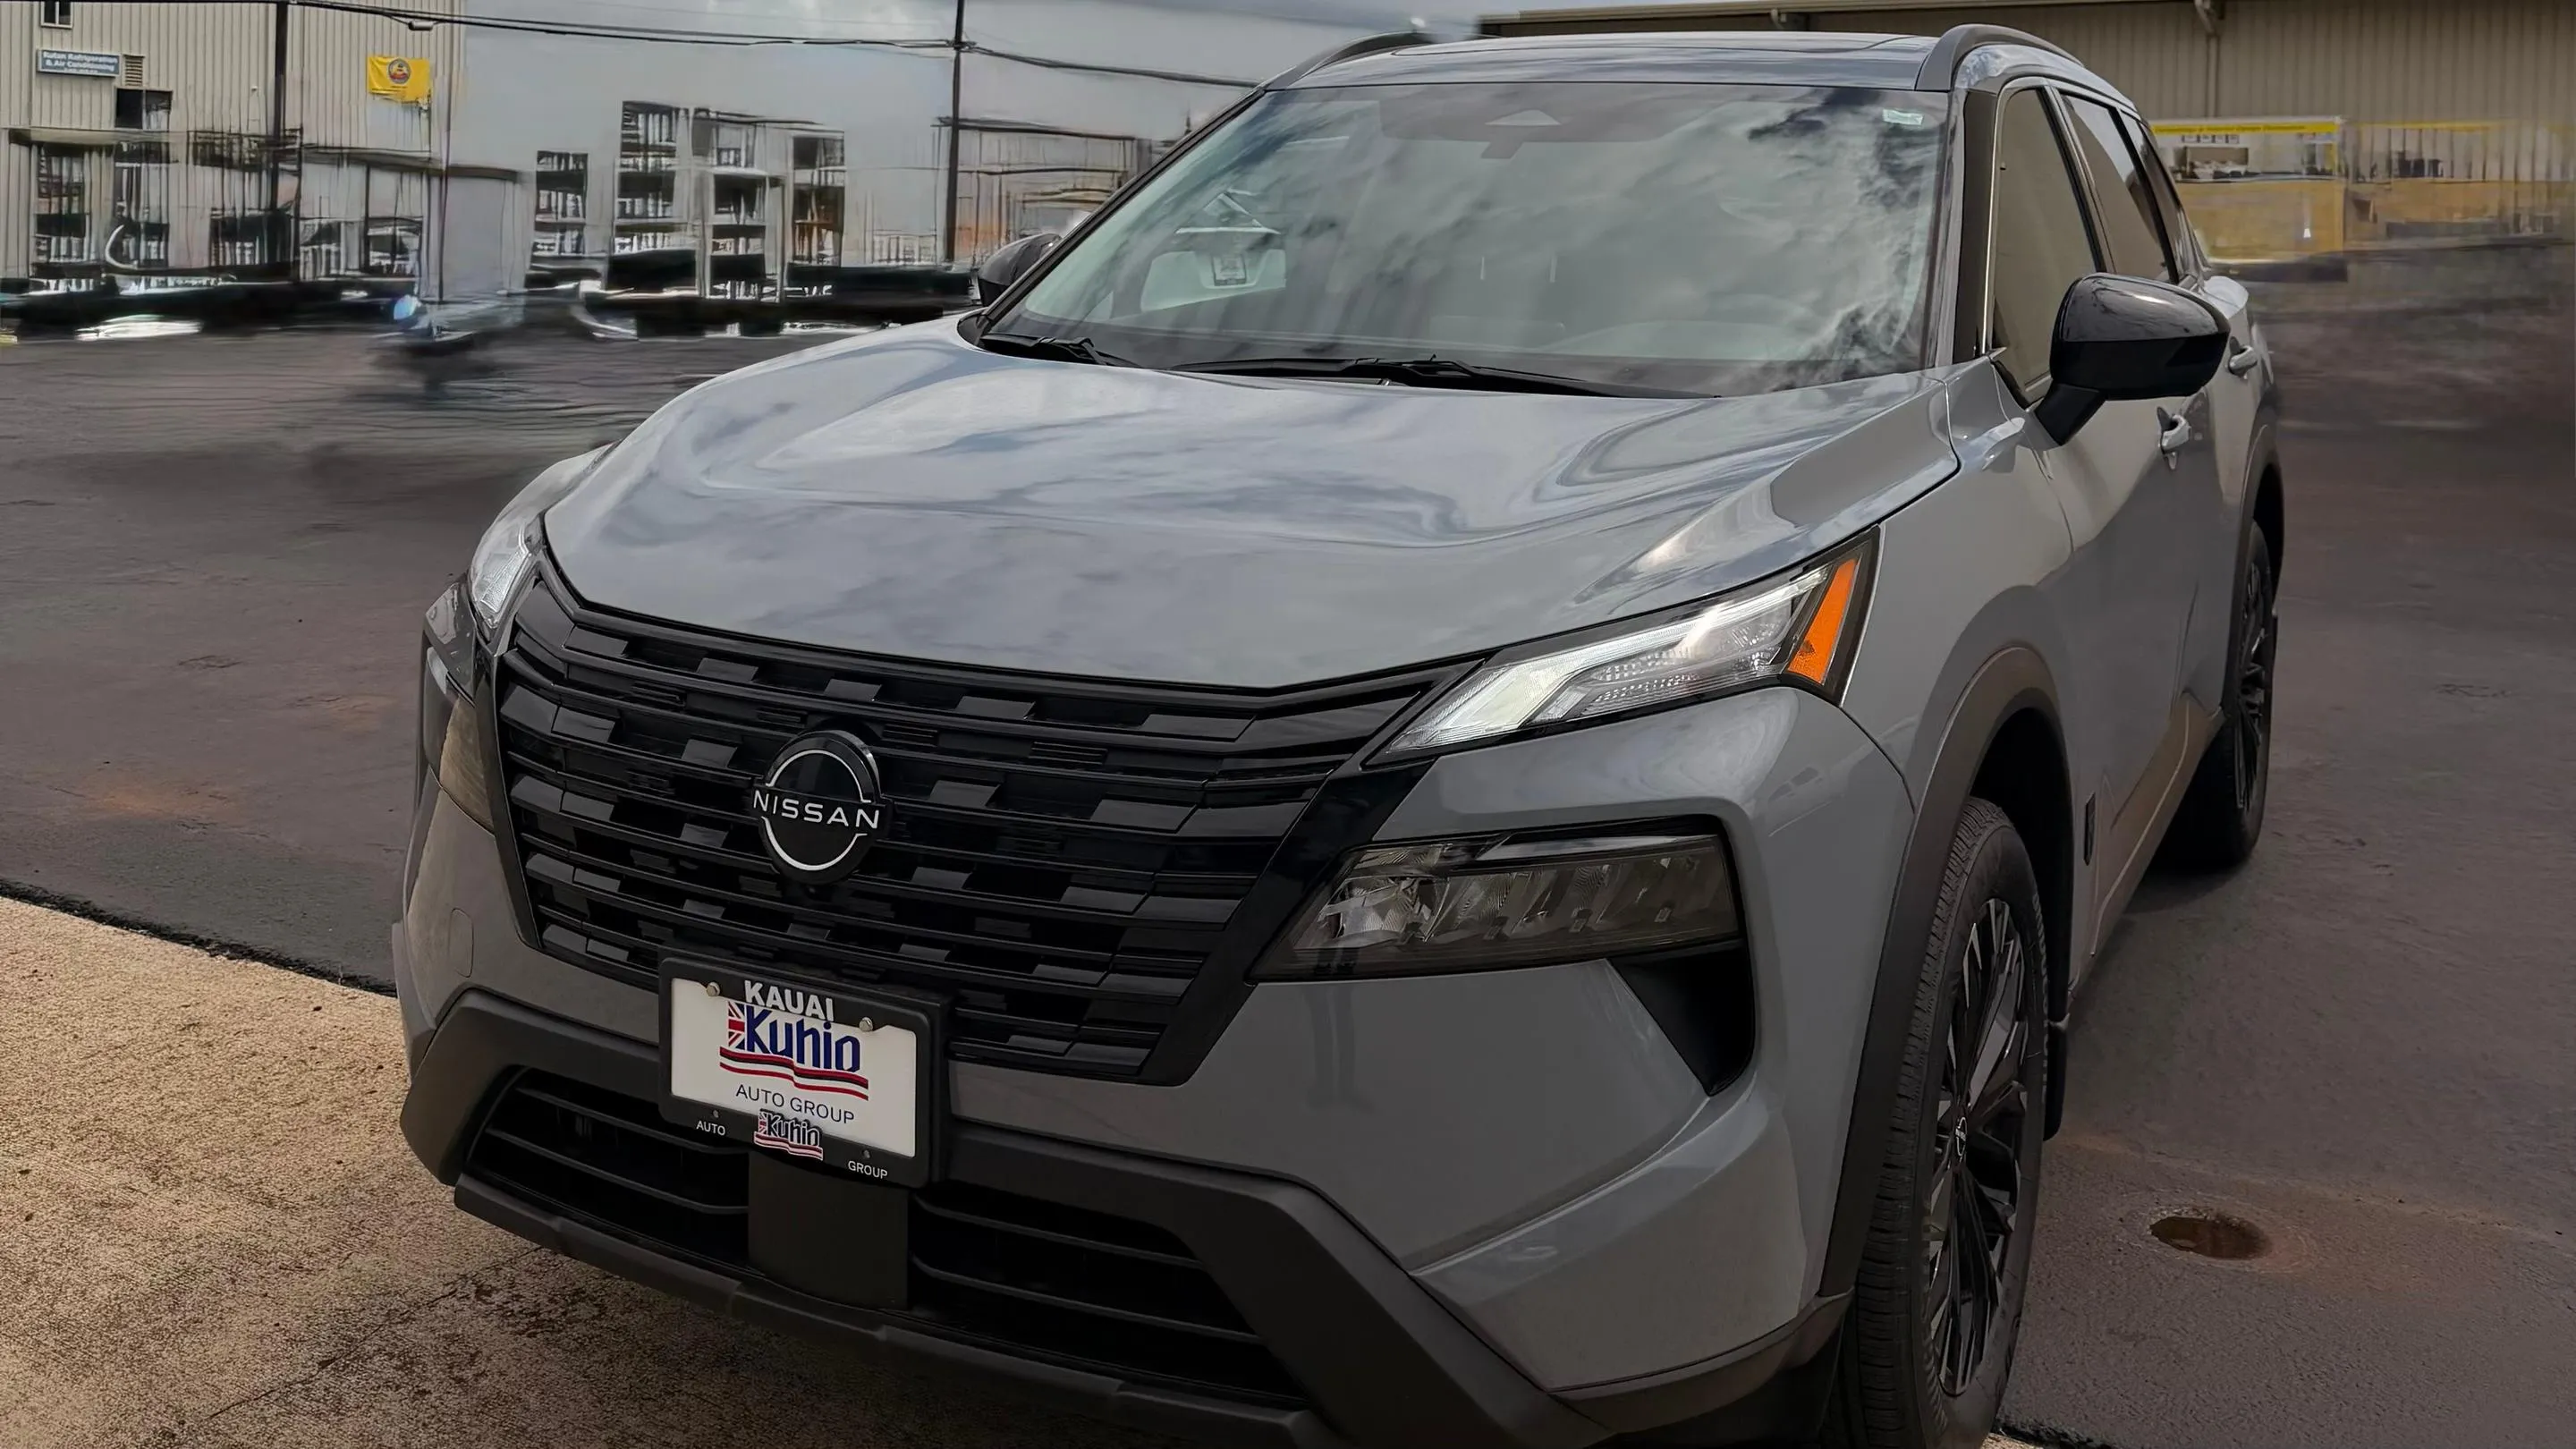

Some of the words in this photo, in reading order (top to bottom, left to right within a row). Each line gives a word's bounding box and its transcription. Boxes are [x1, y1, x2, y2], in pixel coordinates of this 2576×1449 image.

[753, 790, 879, 828] NISSAN
[744, 979, 834, 1021] KAUAI
[745, 1007, 860, 1073] Kuhio
[735, 1083, 784, 1108] AUTO
[790, 1097, 854, 1124] GROUP
[696, 1119, 725, 1136] AUTO
[848, 1160, 888, 1180] GROUP
